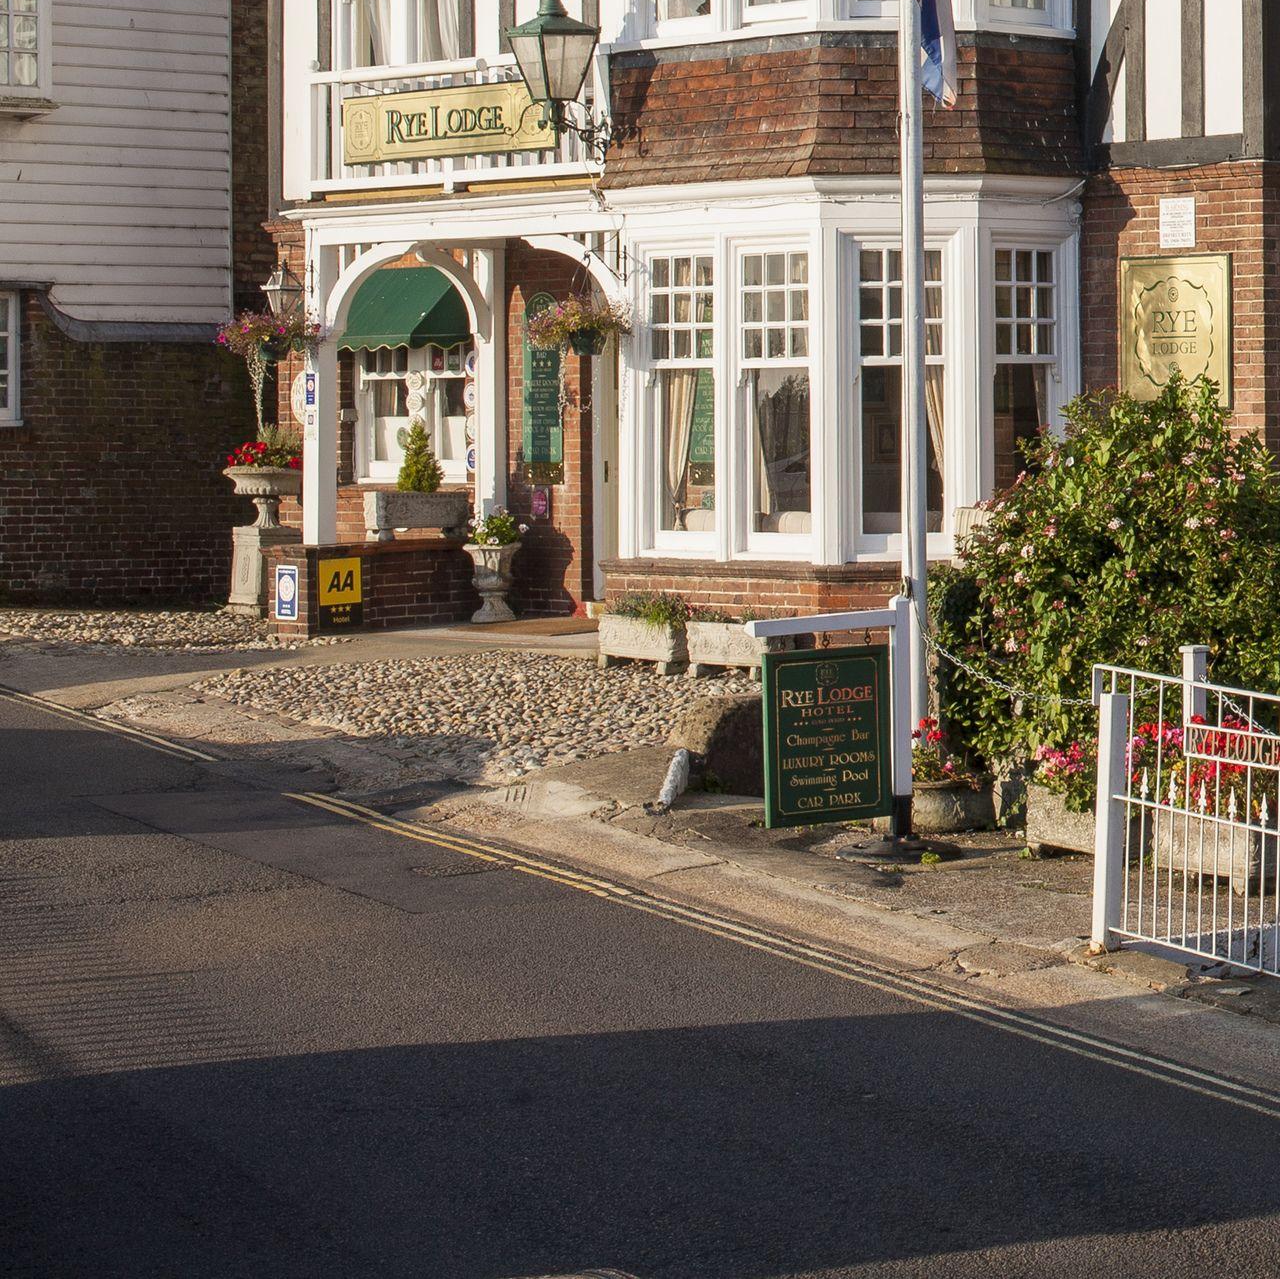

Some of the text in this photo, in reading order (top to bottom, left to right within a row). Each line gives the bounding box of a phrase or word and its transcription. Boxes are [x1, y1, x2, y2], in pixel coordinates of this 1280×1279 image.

[385, 105, 504, 144] RYE LODGE
[1152, 311, 1197, 333] RYE
[1152, 341, 1197, 355] LODGE
[327, 570, 354, 593] AA
[333, 616, 351, 624] Hotel
[781, 685, 873, 708] RYE LODGE
[801, 705, 854, 717] HOTEL
[786, 728, 870, 747] Champagne Bar
[1188, 726, 1221, 758] RYE
[783, 750, 876, 770] LUXURY ROOMS
[790, 769, 869, 787] Swimming Pool
[797, 792, 862, 809] CAR PARK
